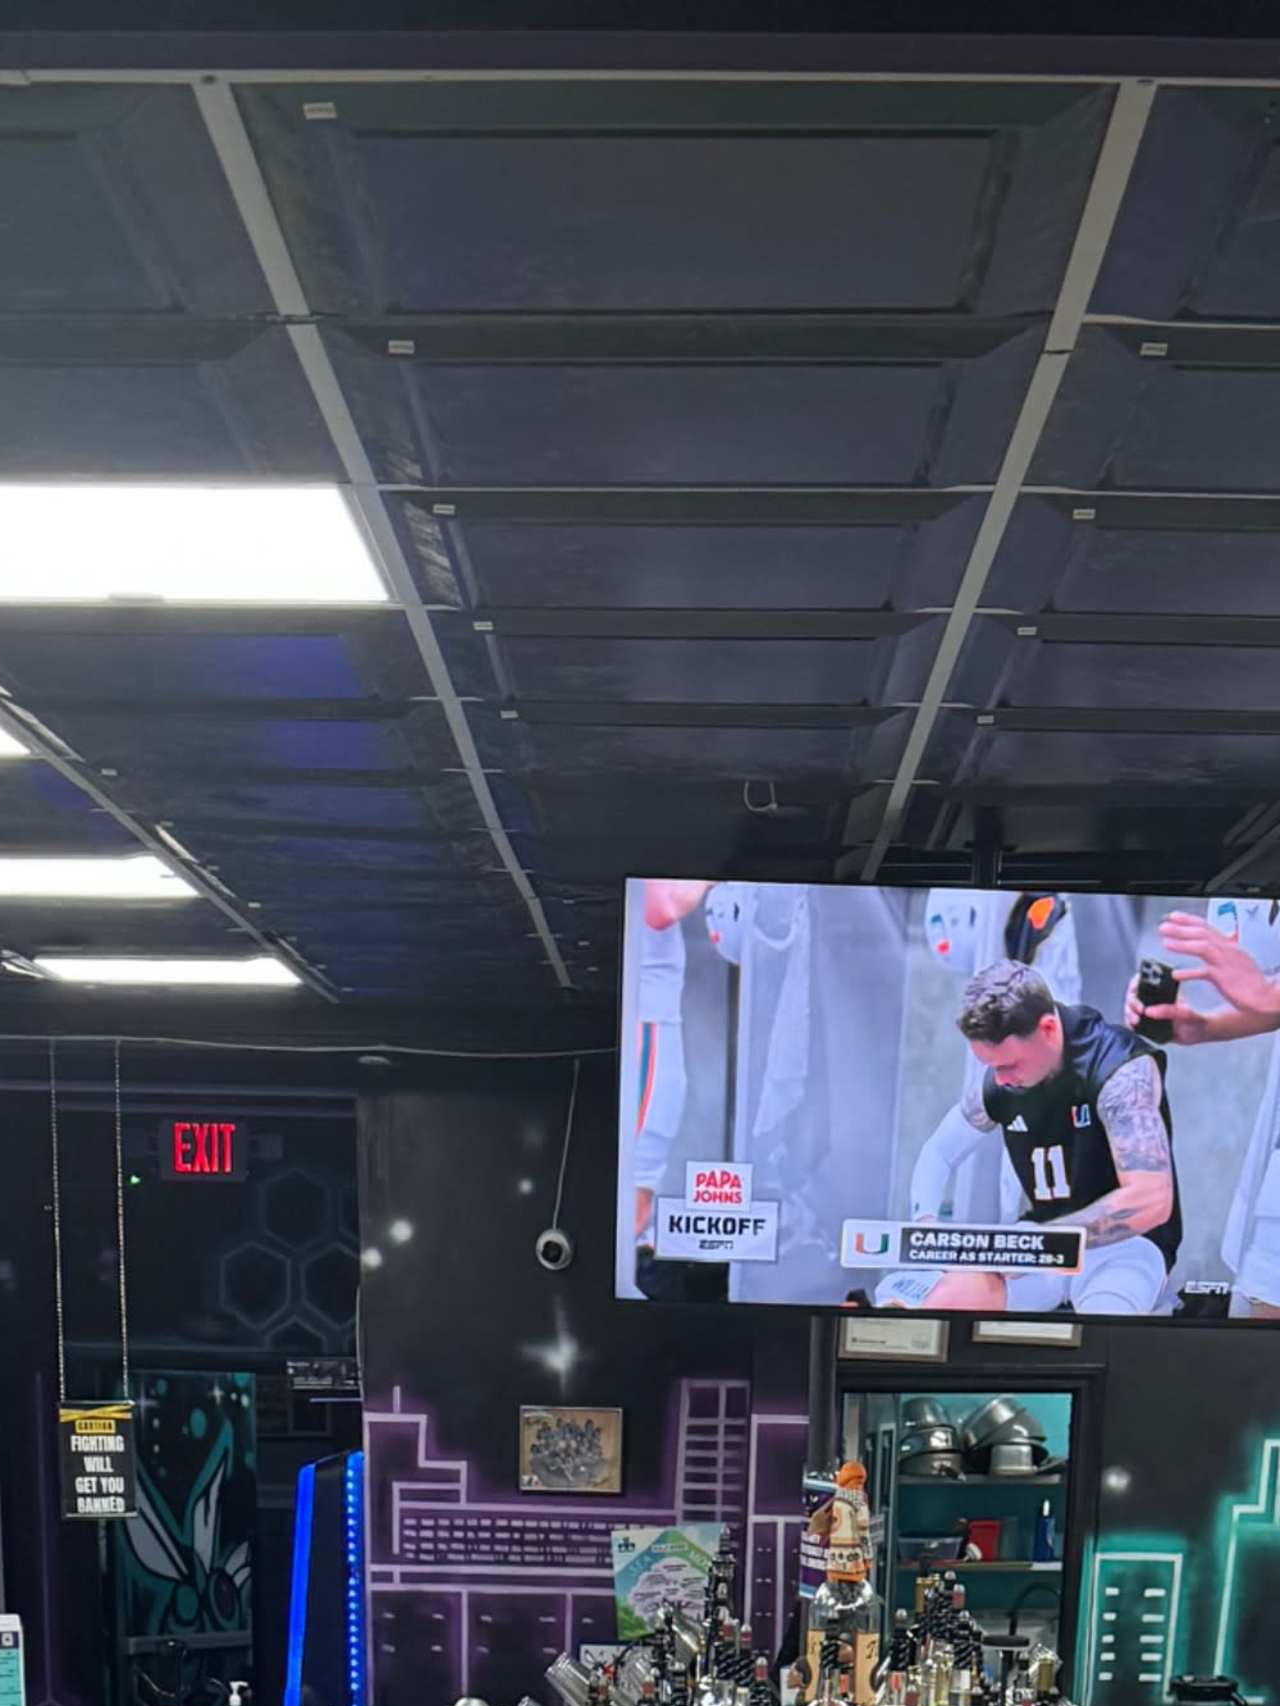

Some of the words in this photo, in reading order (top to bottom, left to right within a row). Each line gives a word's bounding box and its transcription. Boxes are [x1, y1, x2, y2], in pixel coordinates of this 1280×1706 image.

[174, 1122, 236, 1173] EXIT
[695, 1170, 742, 1189] PAPA
[1031, 1145, 1071, 1200] 11
[694, 1190, 742, 1204] JOHNS
[669, 1215, 766, 1236] KICKOFF
[910, 1231, 990, 1248] CARSON
[993, 1233, 1045, 1251] BECK
[909, 1249, 958, 1261] CAREER
[959, 1250, 976, 1262] AS
[978, 1252, 1037, 1264] STARTER:
[1184, 1280, 1229, 1294] ESPN
[70, 1435, 125, 1452] FIGHTING
[83, 1456, 114, 1472] WILL
[75, 1477, 98, 1494] GET
[100, 1477, 125, 1494] YOU
[77, 1496, 125, 1513] BANNED
